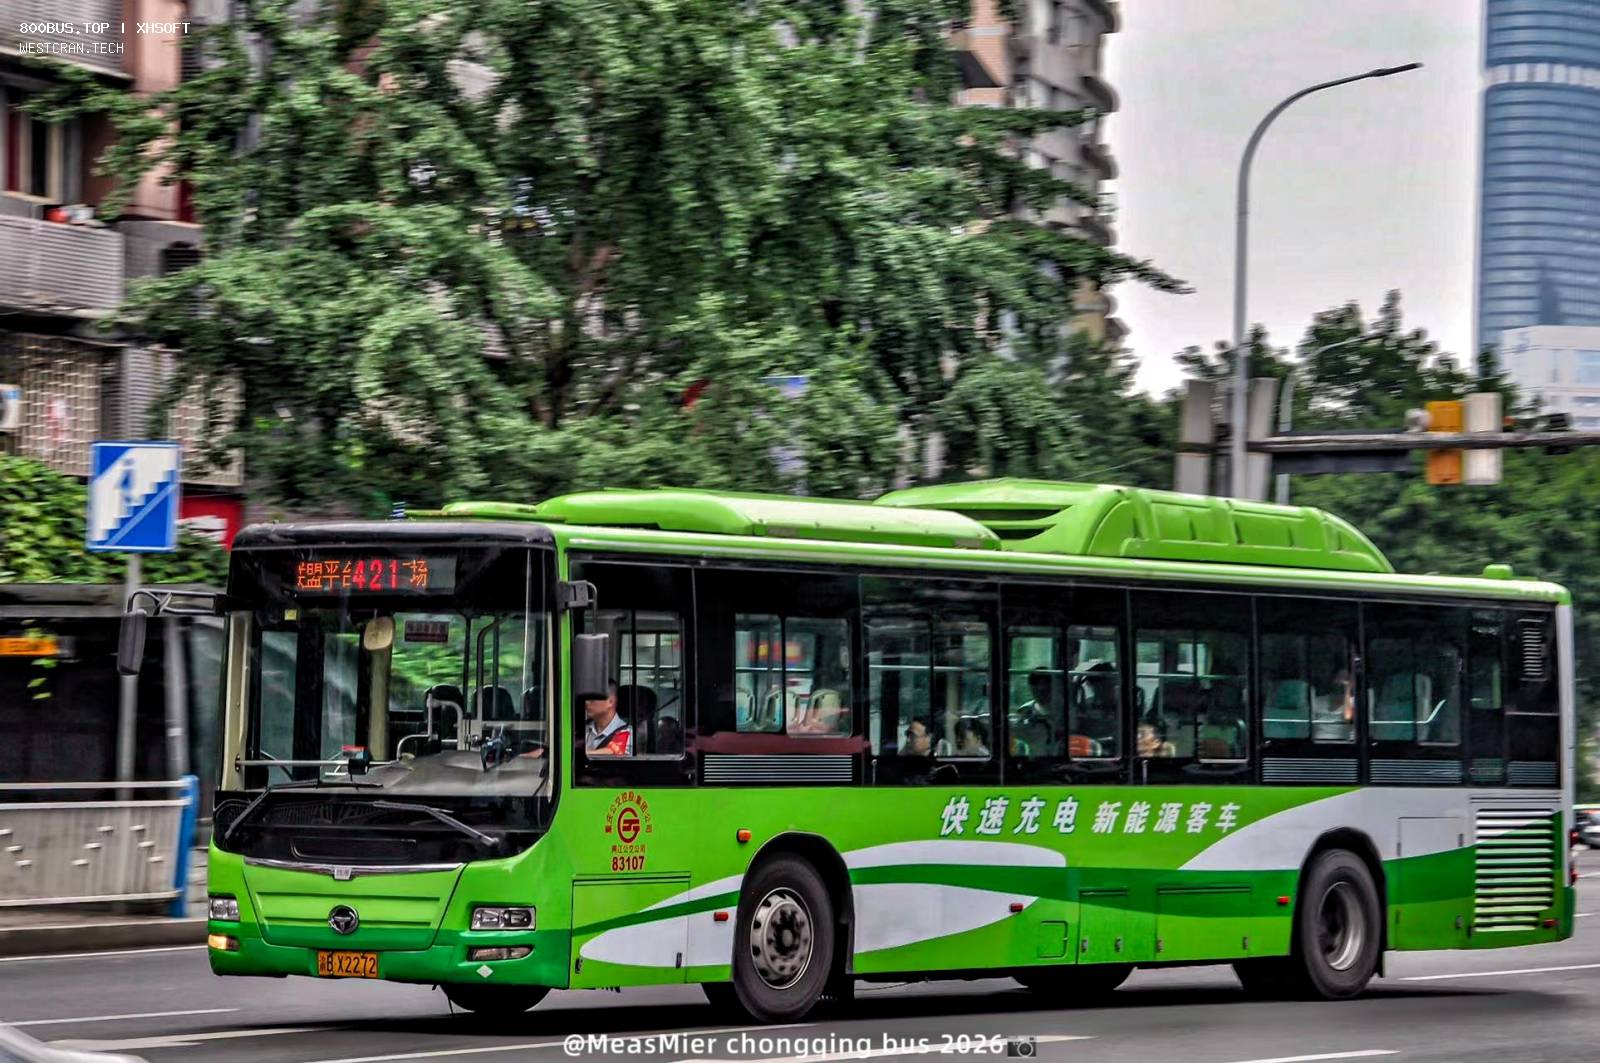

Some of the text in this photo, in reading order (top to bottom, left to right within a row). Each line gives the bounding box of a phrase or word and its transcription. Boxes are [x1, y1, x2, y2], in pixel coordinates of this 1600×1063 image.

[353, 560, 398, 588] 421
[940, 796, 1241, 836] 快速充电 新能源客车
[612, 856, 645, 871] 83107
